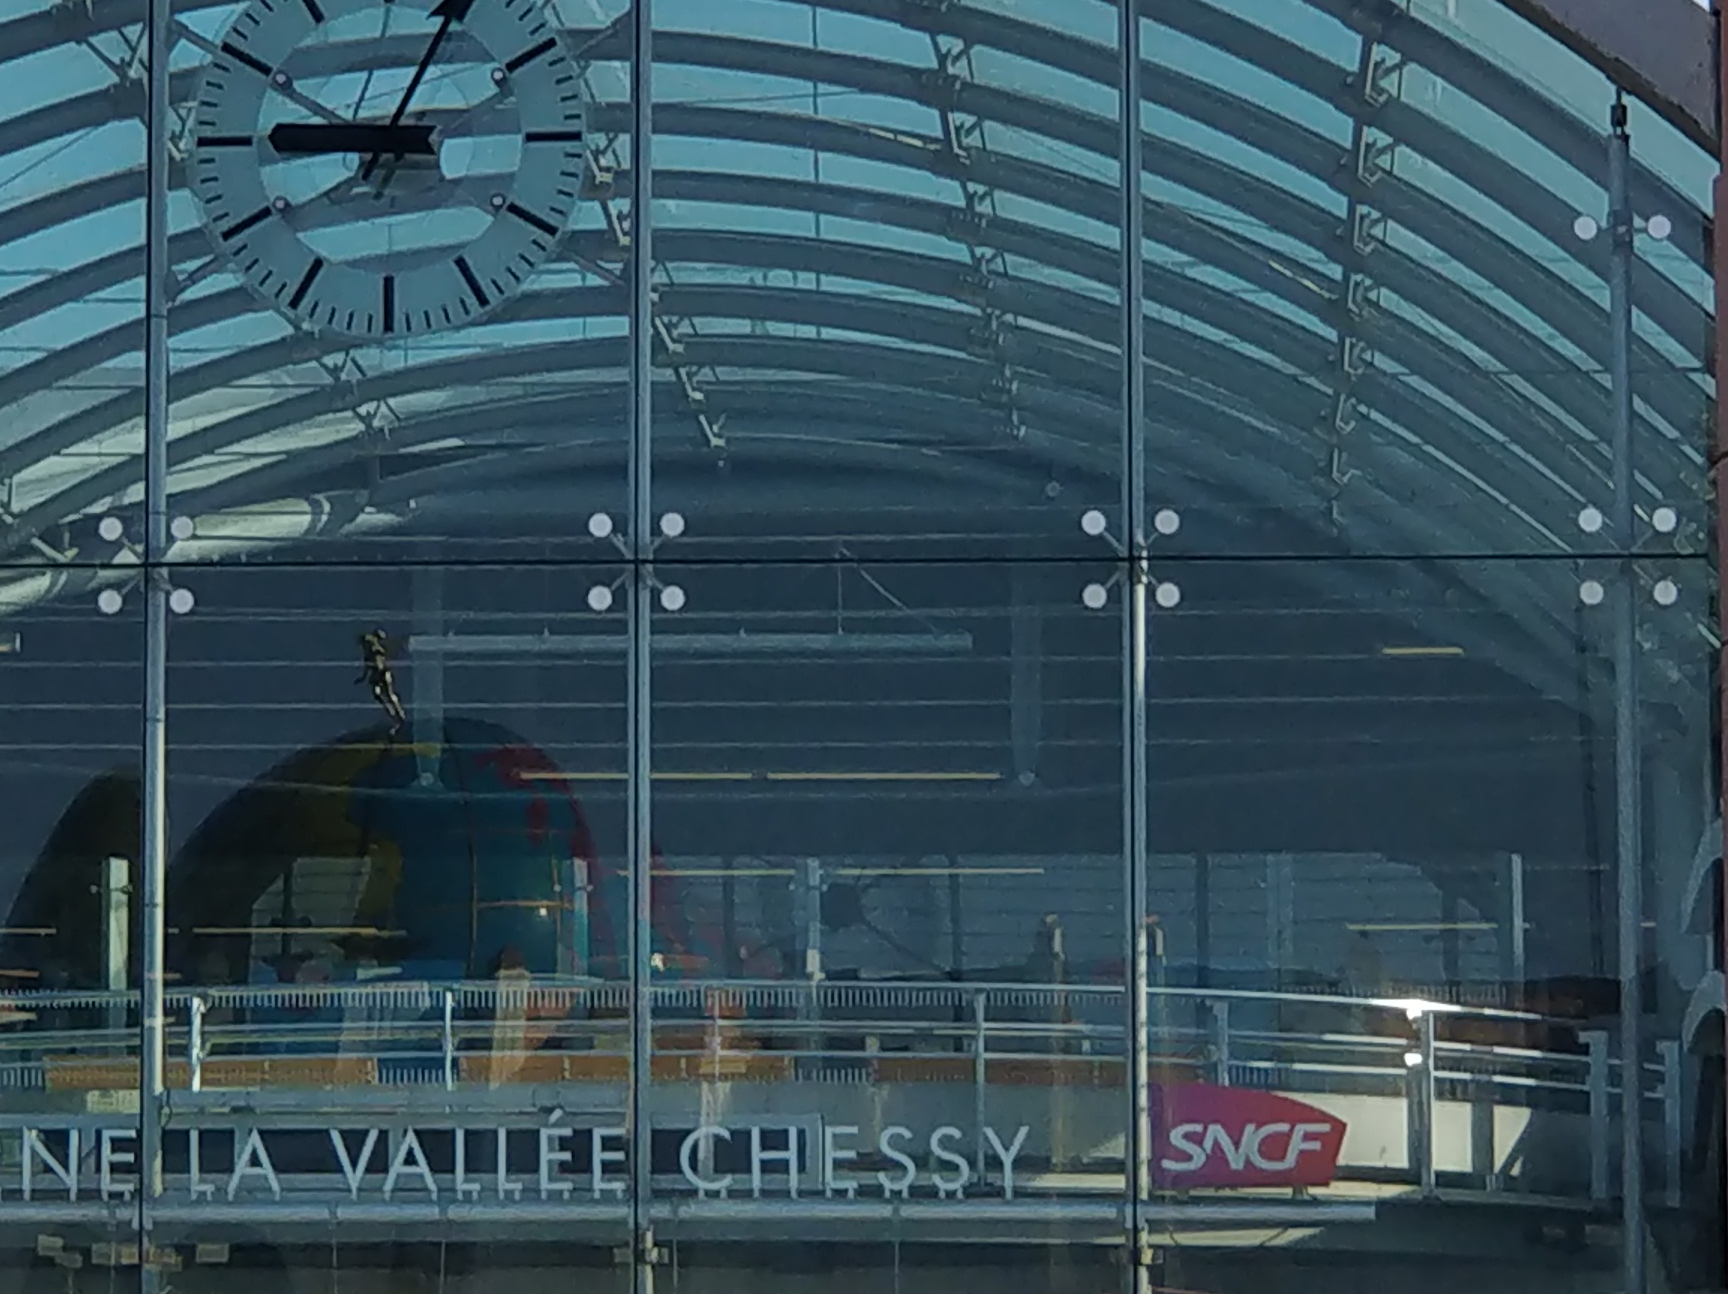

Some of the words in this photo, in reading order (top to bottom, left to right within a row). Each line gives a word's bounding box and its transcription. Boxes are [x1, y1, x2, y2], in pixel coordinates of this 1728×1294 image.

[187, 1126, 281, 1198] LA
[329, 1109, 630, 1197] VALLÉE
[680, 1124, 1031, 1197] CHESSY
[1161, 1122, 1332, 1173] SNCF
